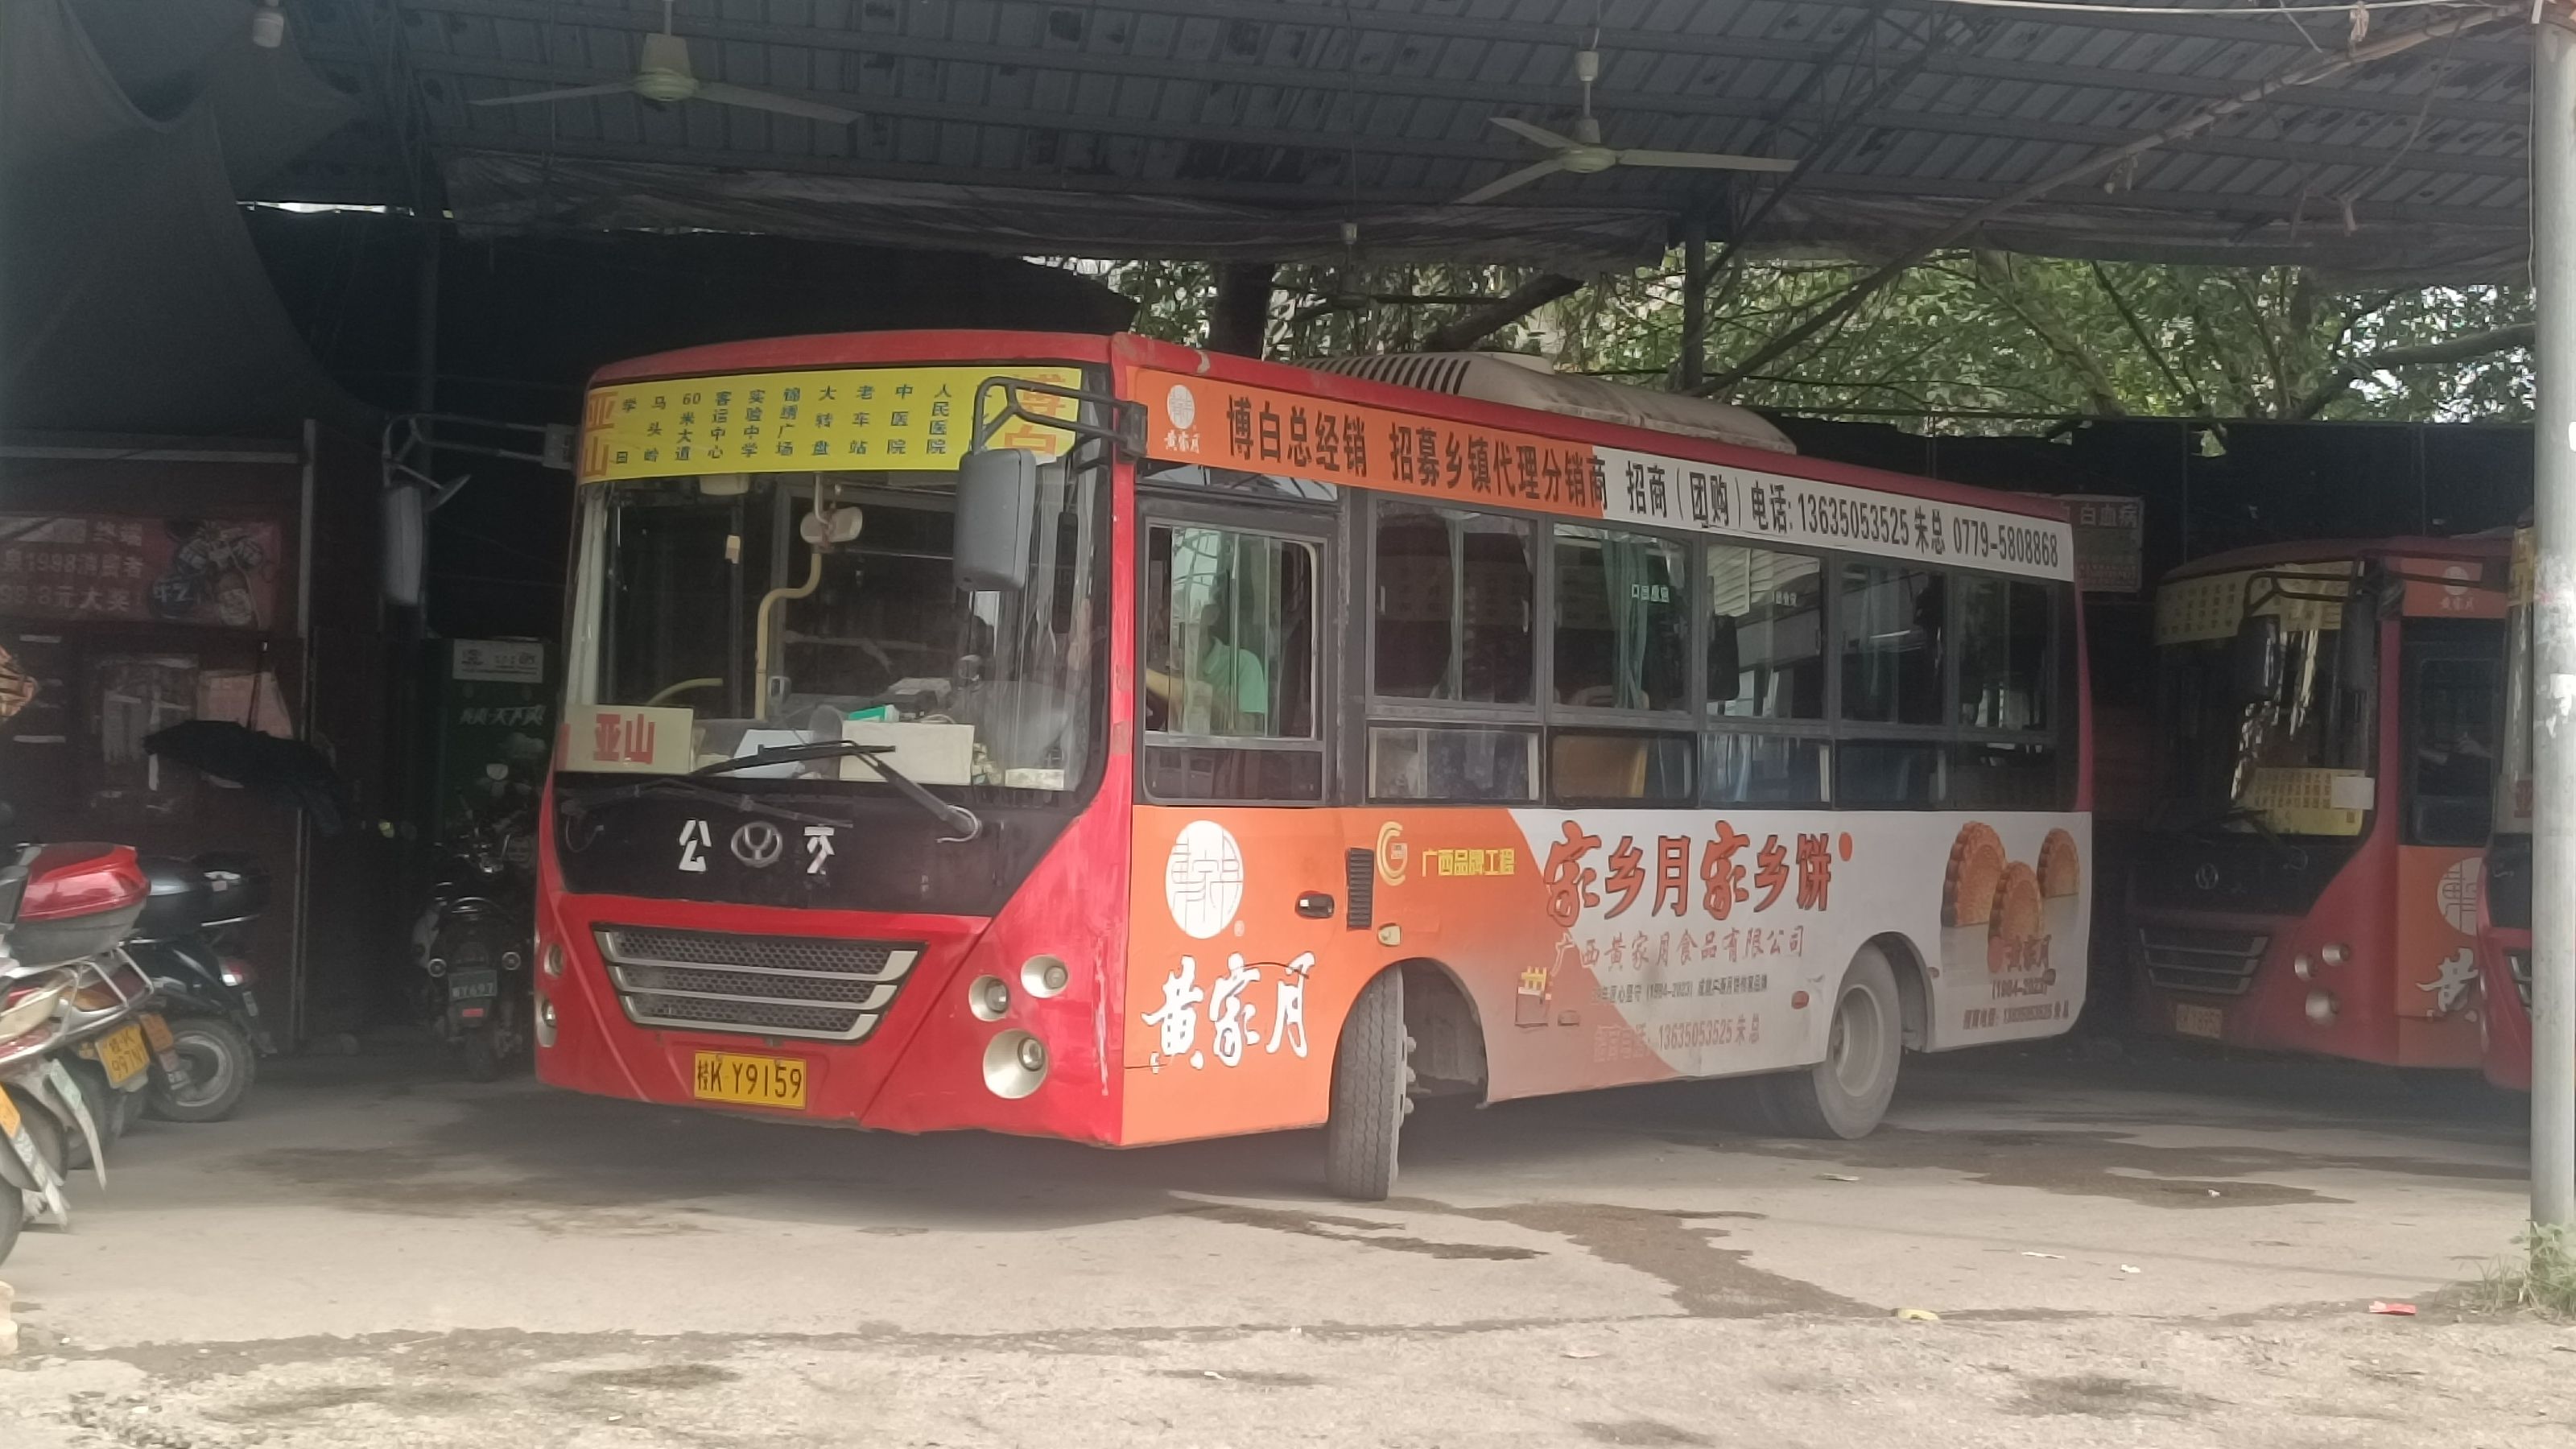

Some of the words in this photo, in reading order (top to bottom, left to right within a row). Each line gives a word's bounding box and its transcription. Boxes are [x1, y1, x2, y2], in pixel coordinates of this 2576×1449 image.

[583, 391, 618, 477] 亚山
[741, 389, 766, 458] 实验中学
[848, 385, 875, 455] 老车站
[886, 384, 913, 455] 中医院
[925, 383, 952, 455] 人民医院
[1226, 394, 1368, 477] 博白总经销
[1389, 421, 1607, 511] 招募乡镇代理分销商
[1913, 507, 1946, 555] 朱总
[1953, 522, 2059, 568] 0779-5808868
[593, 713, 655, 764] 亚山
[1422, 847, 1515, 877] 广西品牌工程
[1550, 925, 1805, 977] 广西黄家月食品有限公司
[1141, 951, 1315, 1073] 黄家月
[1658, 1018, 1733, 1051] 13635053525
